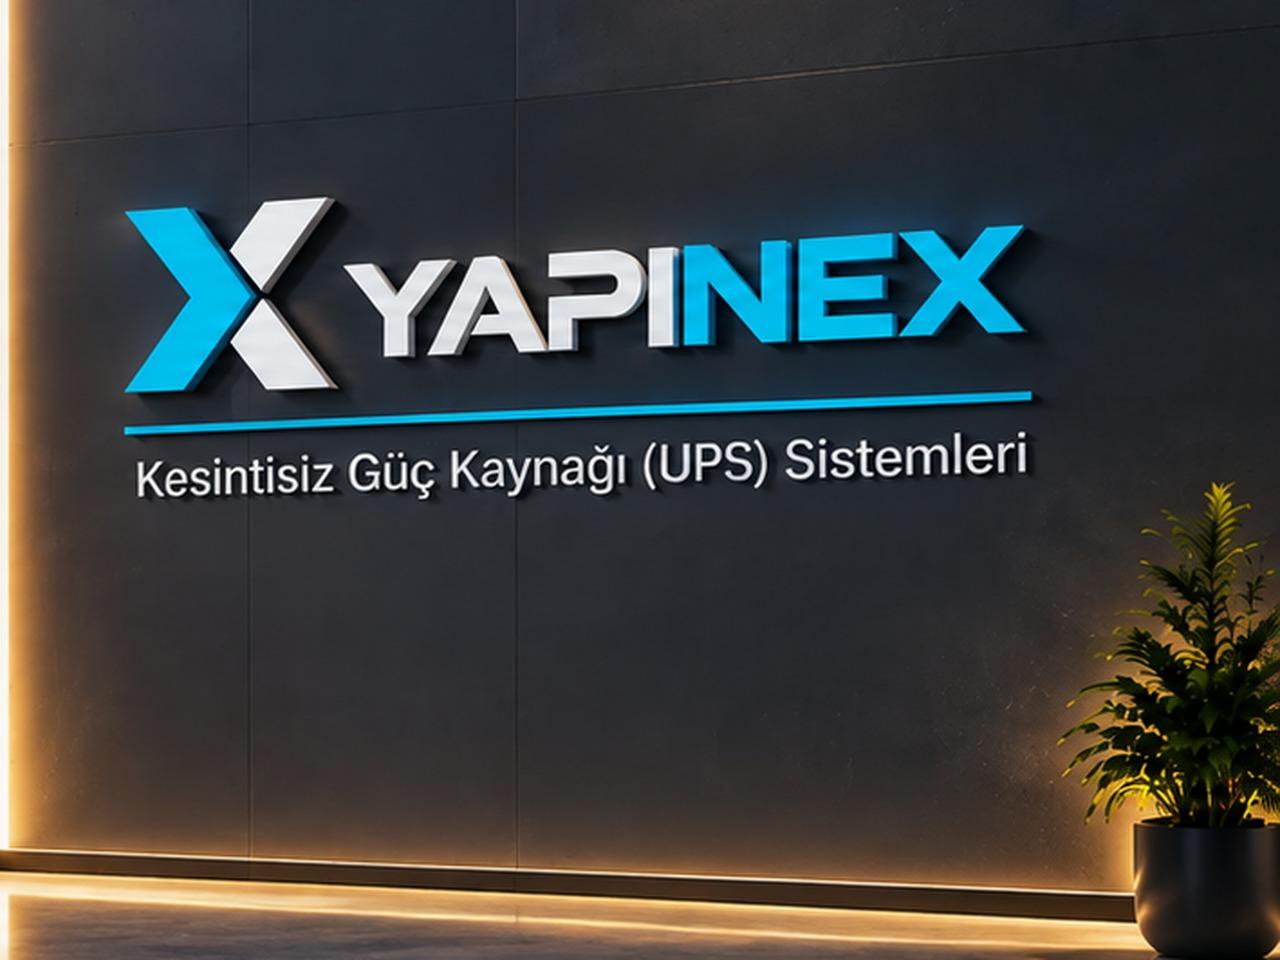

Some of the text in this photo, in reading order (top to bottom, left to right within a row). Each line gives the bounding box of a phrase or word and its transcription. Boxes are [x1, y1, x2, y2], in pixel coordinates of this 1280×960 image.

[344, 225, 1026, 357] YAPINEX
[137, 431, 1027, 500] Kesintisiz Güç Kaynağı (UPS) Sistemleri
